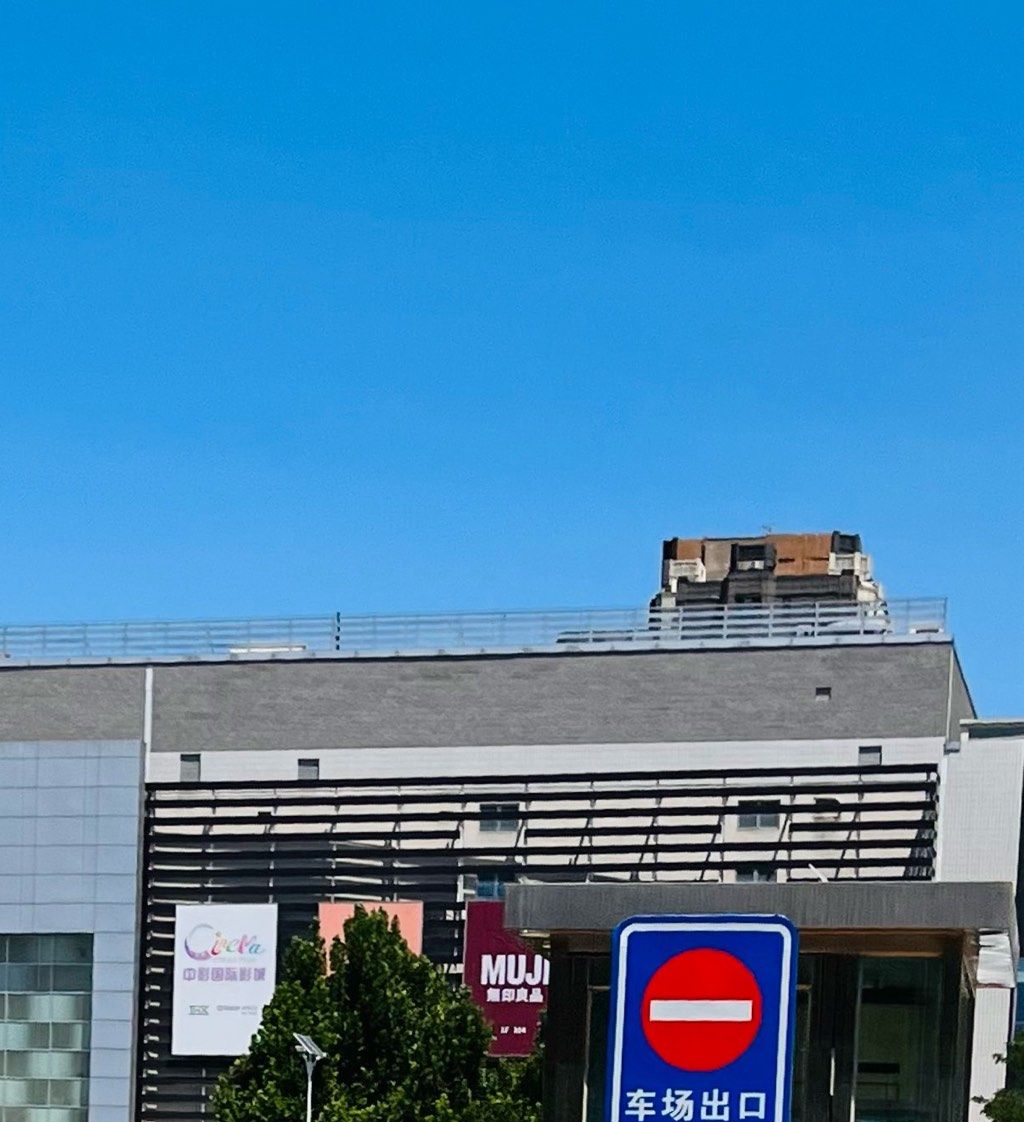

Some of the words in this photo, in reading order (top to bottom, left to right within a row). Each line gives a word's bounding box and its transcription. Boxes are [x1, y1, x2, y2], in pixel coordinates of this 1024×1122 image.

[480, 953, 551, 986] MUJI
[624, 1087, 767, 1122] 车场出口
